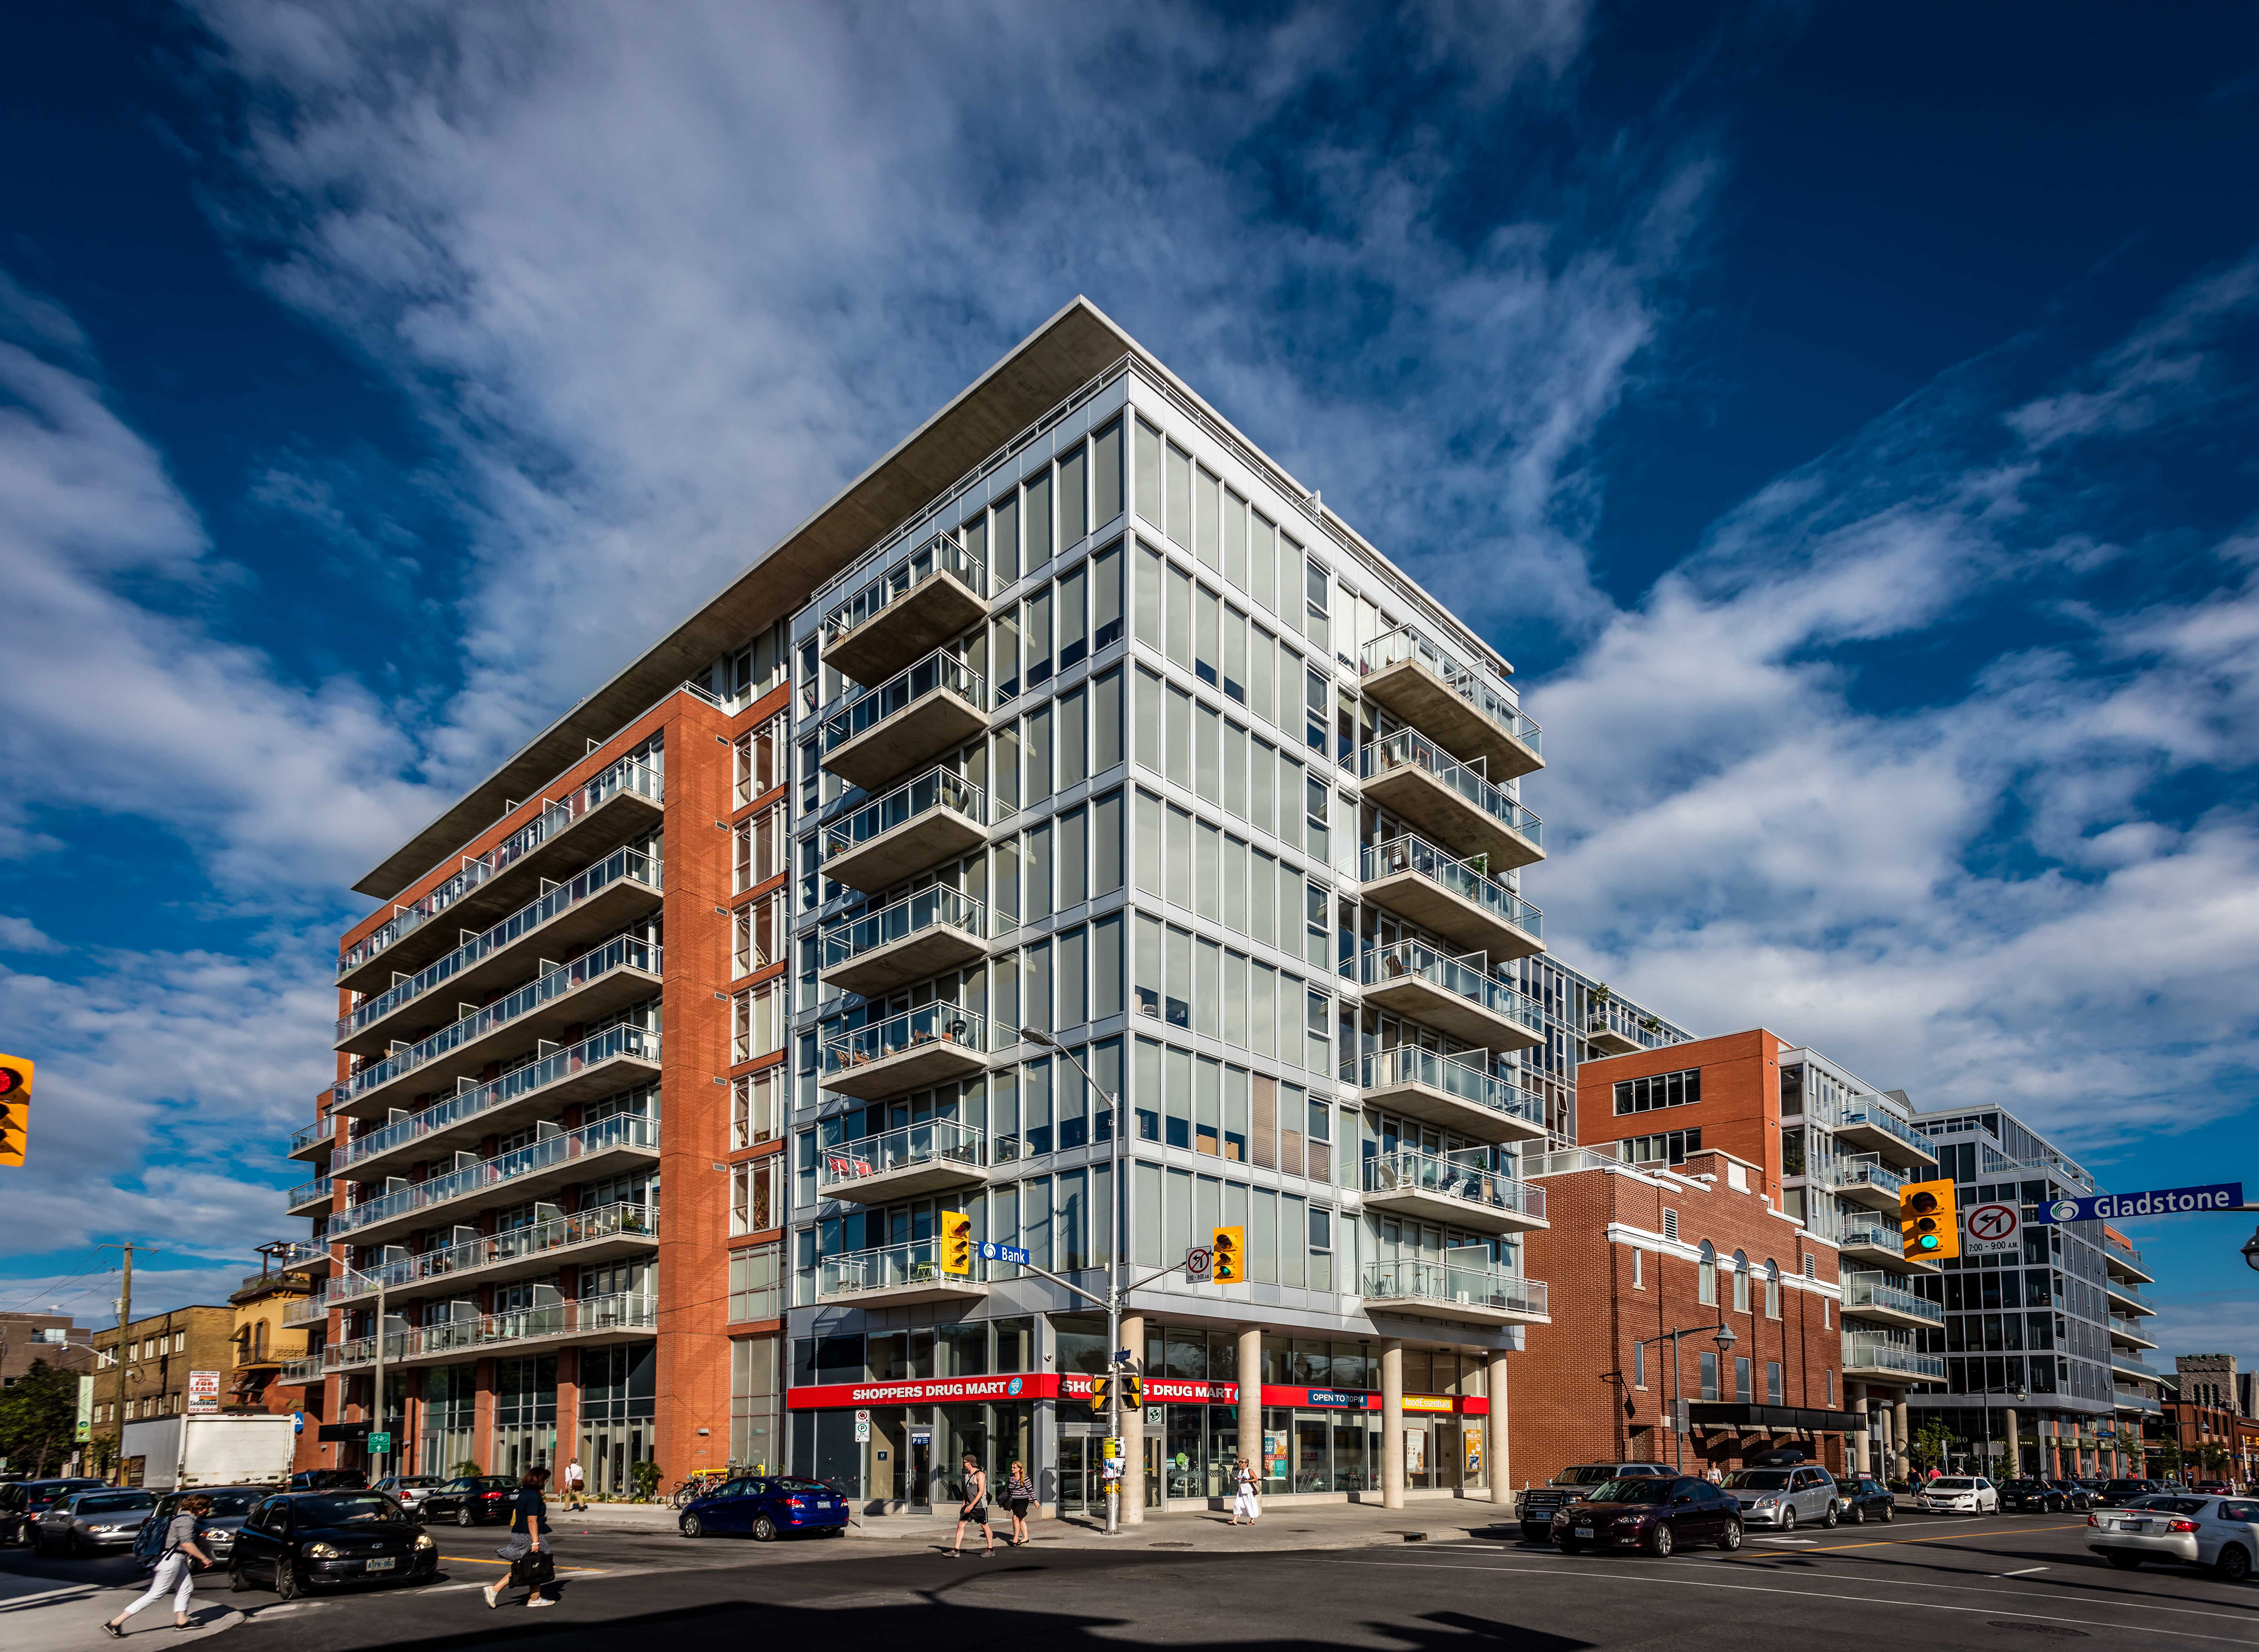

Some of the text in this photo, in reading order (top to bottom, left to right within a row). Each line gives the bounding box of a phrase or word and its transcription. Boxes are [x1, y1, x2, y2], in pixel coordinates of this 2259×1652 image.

[2094, 1191, 2230, 1217] Gladstone
[1969, 1243, 1983, 1252] 7:00
[1991, 1241, 2006, 1249] 9:00
[1002, 1247, 1025, 1264] Bank
[852, 1382, 1006, 1400] SHOPPERS DRUG MART
[1153, 1384, 1192, 1397] DRUG
[1195, 1387, 1232, 1398] MART
[1313, 1393, 1333, 1402] OPEN
